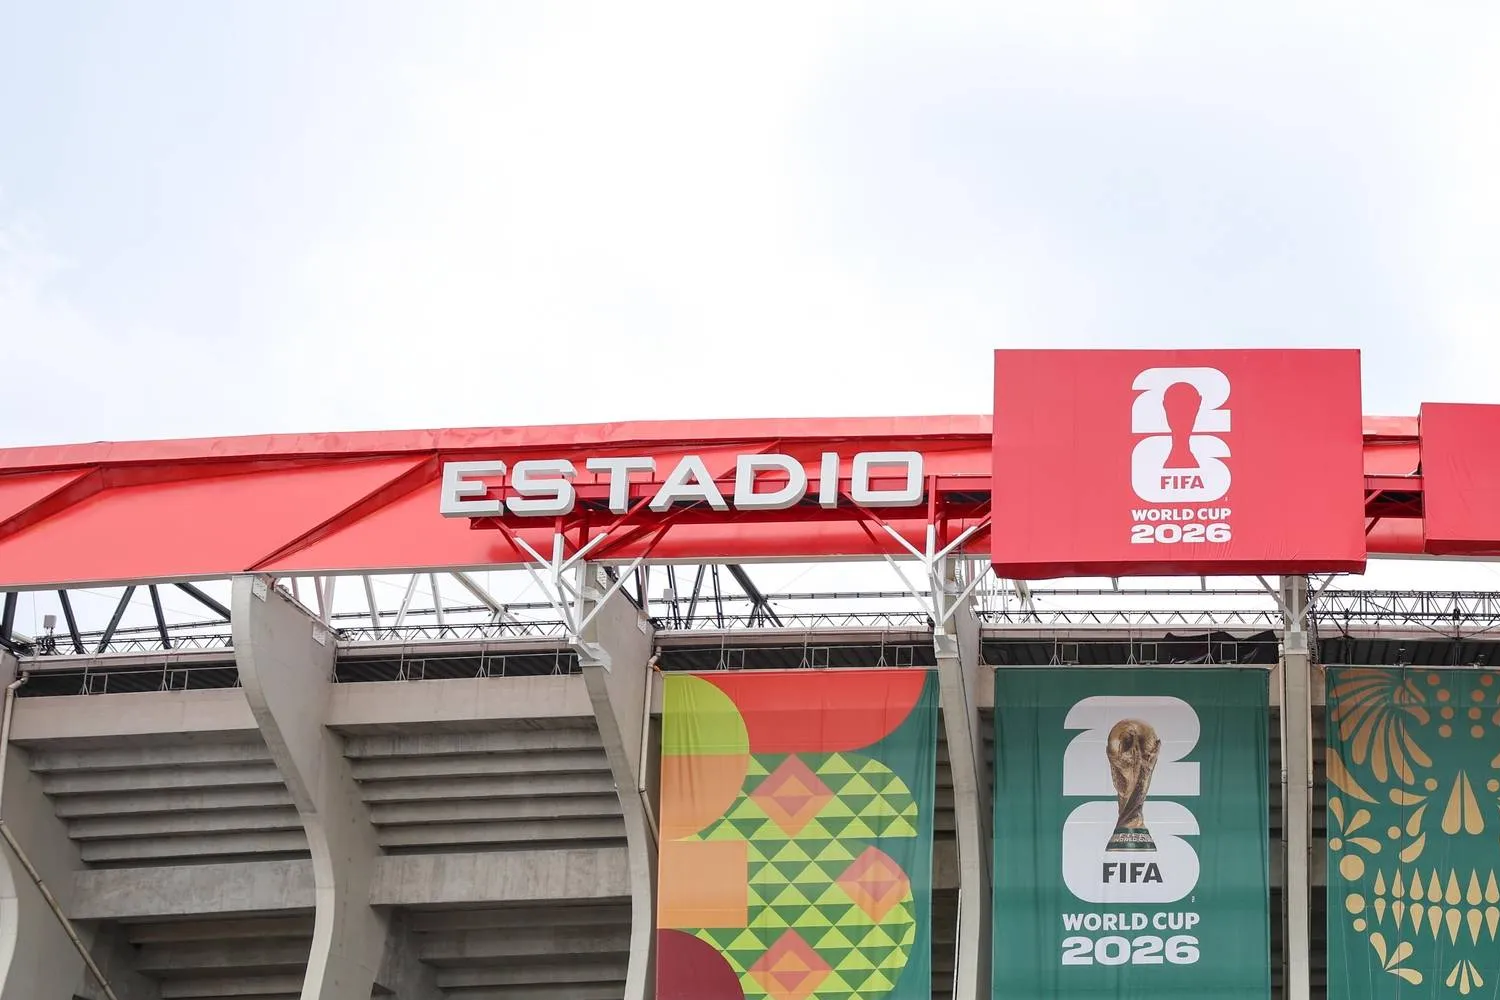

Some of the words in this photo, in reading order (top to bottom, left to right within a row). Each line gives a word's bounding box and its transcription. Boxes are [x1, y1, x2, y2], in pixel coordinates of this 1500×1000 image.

[440, 450, 925, 518] ESTADIO
[1160, 475, 1204, 490] FIFA
[1131, 508, 1194, 522] WORLD
[1197, 507, 1232, 520] CUP
[1131, 523, 1232, 544] 2026
[1102, 862, 1163, 884] FIFA
[1062, 913, 1148, 931] WORLD
[1153, 912, 1200, 930] CUP
[1061, 935, 1200, 966] 2026
